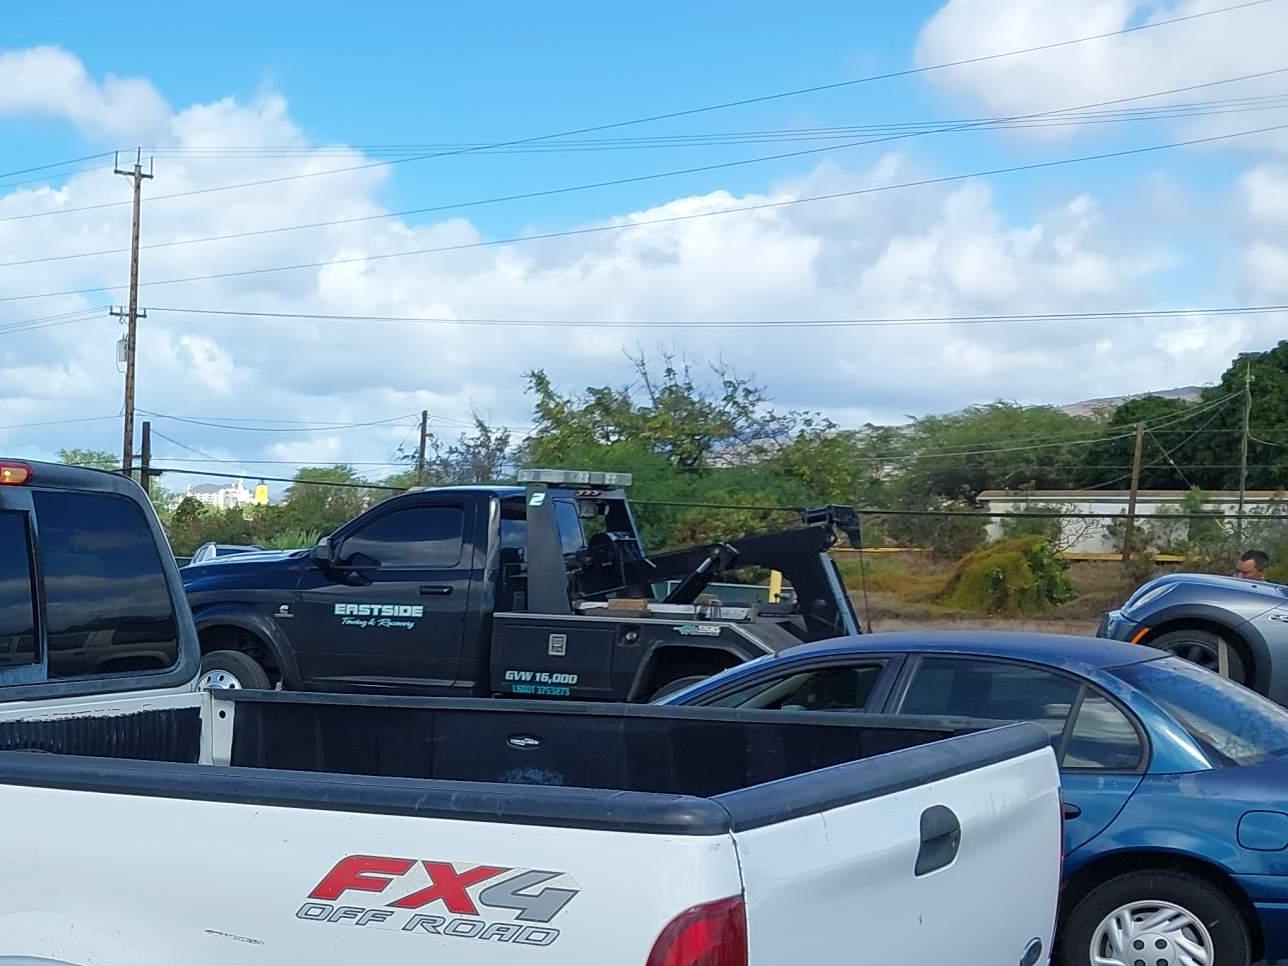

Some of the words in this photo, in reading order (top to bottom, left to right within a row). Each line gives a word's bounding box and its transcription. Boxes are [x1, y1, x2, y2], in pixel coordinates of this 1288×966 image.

[529, 492, 546, 506] 2
[334, 603, 424, 617] EASTSIDE
[505, 670, 533, 681] GVW
[535, 672, 578, 684] 16,000
[307, 854, 581, 923] FX4
[296, 902, 395, 926] OFF
[402, 913, 560, 947] ROAD
